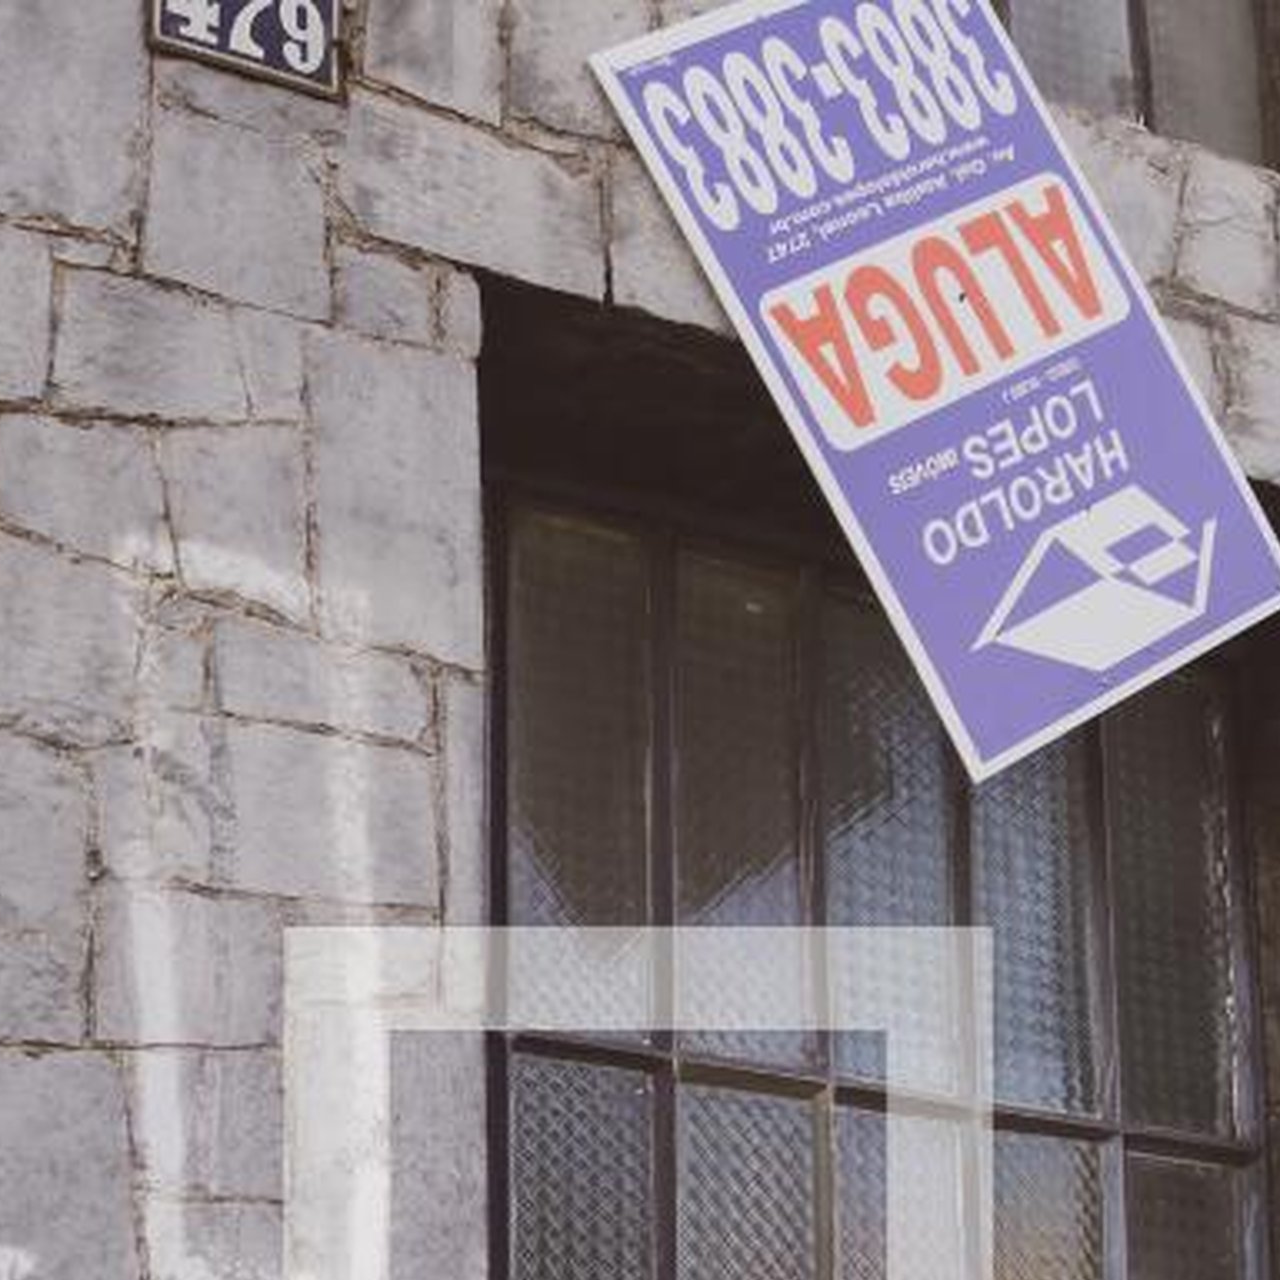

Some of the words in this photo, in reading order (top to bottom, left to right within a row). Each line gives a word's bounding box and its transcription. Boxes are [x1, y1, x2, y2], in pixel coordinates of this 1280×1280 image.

[641, 0, 1018, 232] 3883-3883
[768, 231, 812, 264] 2747
[768, 184, 1103, 429] ALUGA
[922, 428, 1130, 567] HAROLDO
[962, 378, 1103, 480] LOPES
